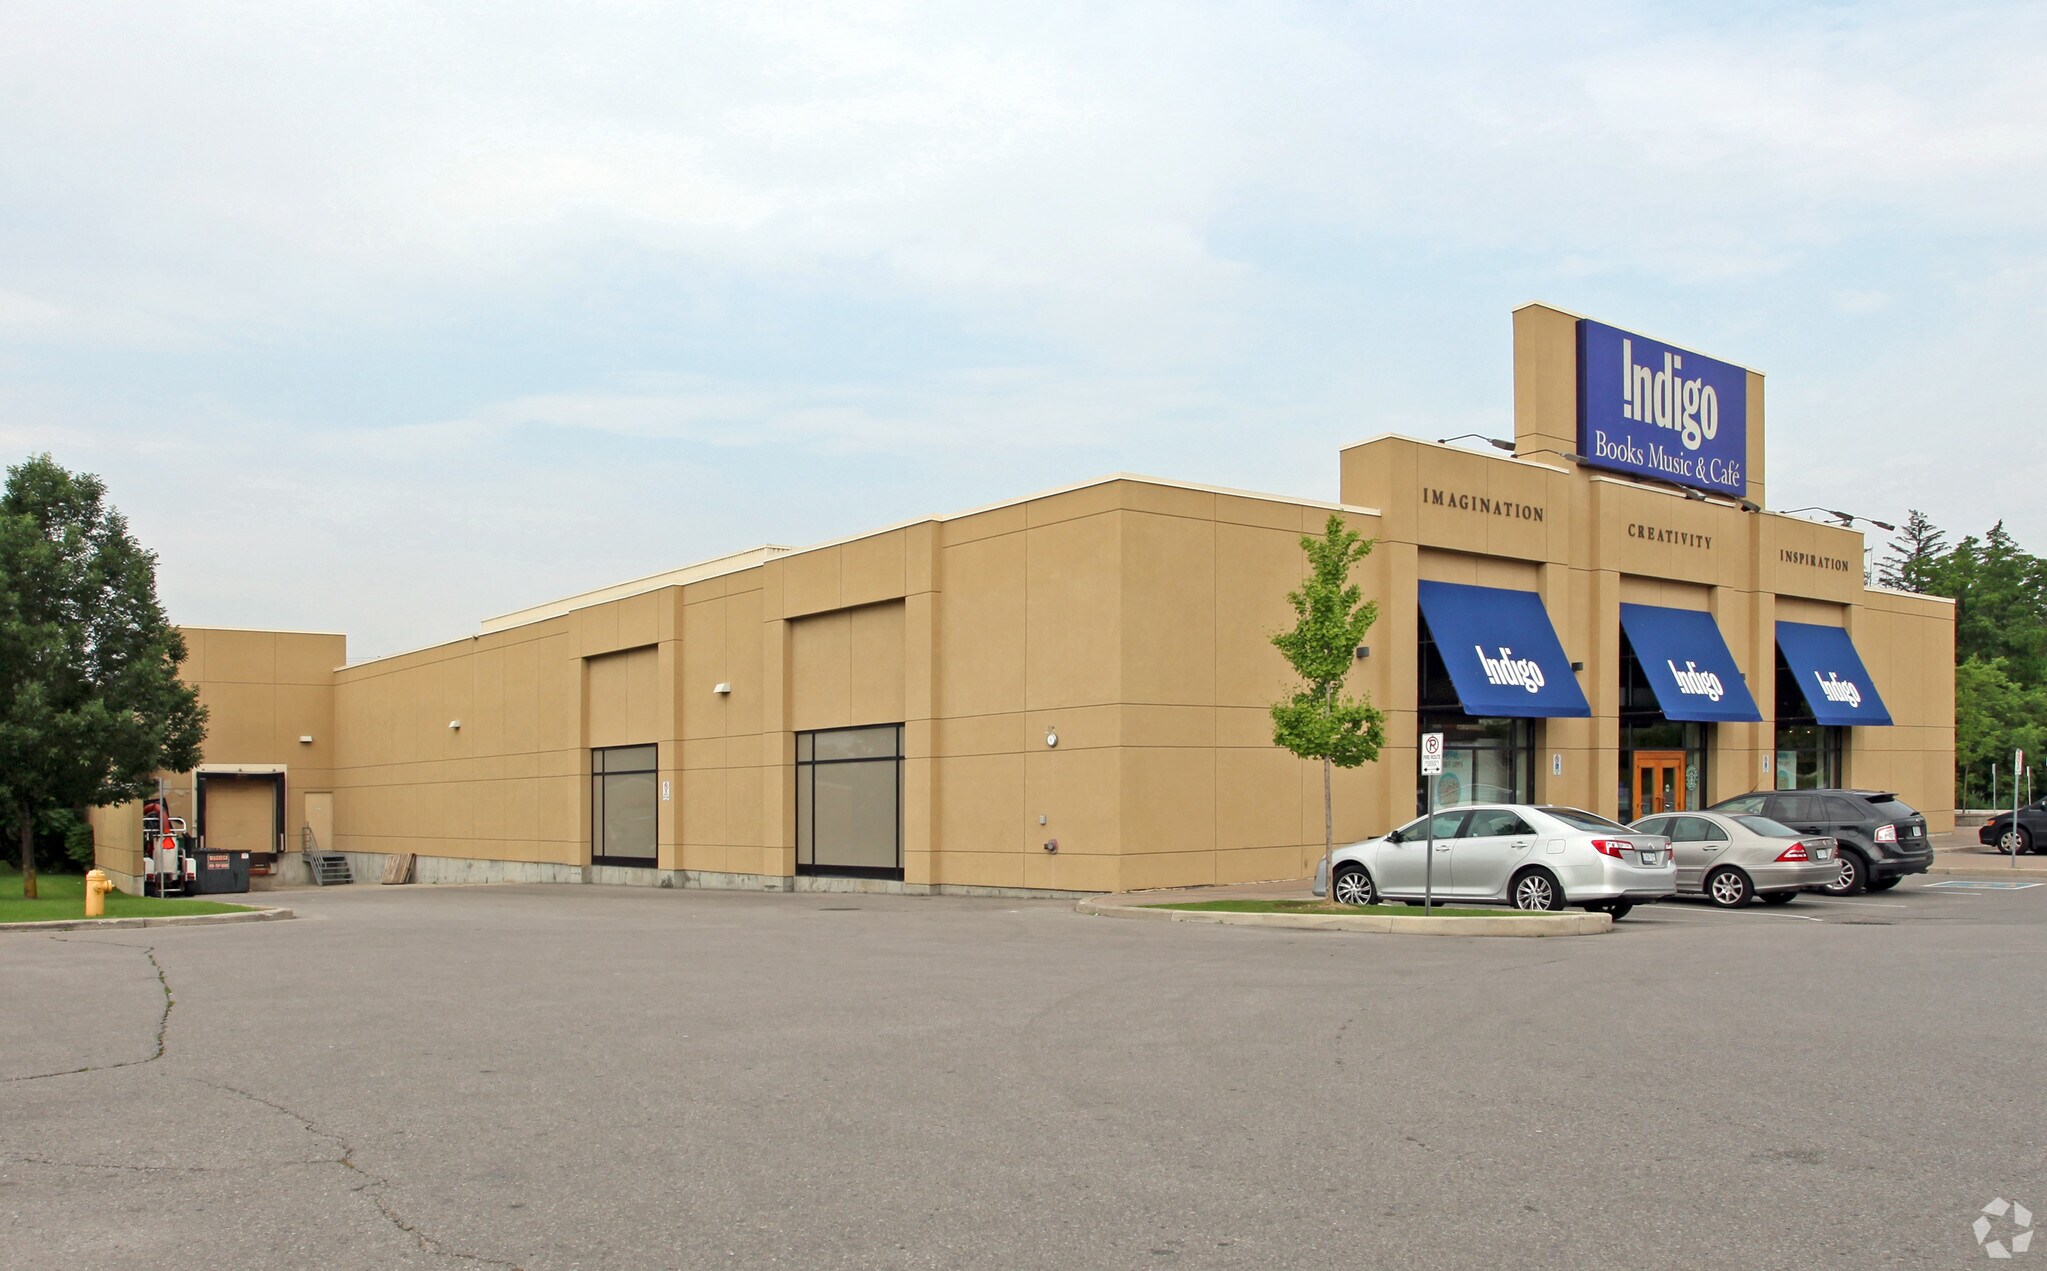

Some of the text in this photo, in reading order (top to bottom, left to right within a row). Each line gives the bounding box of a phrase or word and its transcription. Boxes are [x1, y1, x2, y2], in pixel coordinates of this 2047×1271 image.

[1623, 338, 1718, 450] Indigo
[1595, 430, 1740, 487] Books Music & Café
[1423, 487, 1543, 522] IMAGINATION
[1627, 523, 1712, 549] CREATIVITY
[1780, 549, 1849, 572] INSPIRATION
[1475, 645, 1545, 694] Indigo
[1667, 659, 1724, 702] Indigo
[1814, 670, 1861, 708] Indigo
